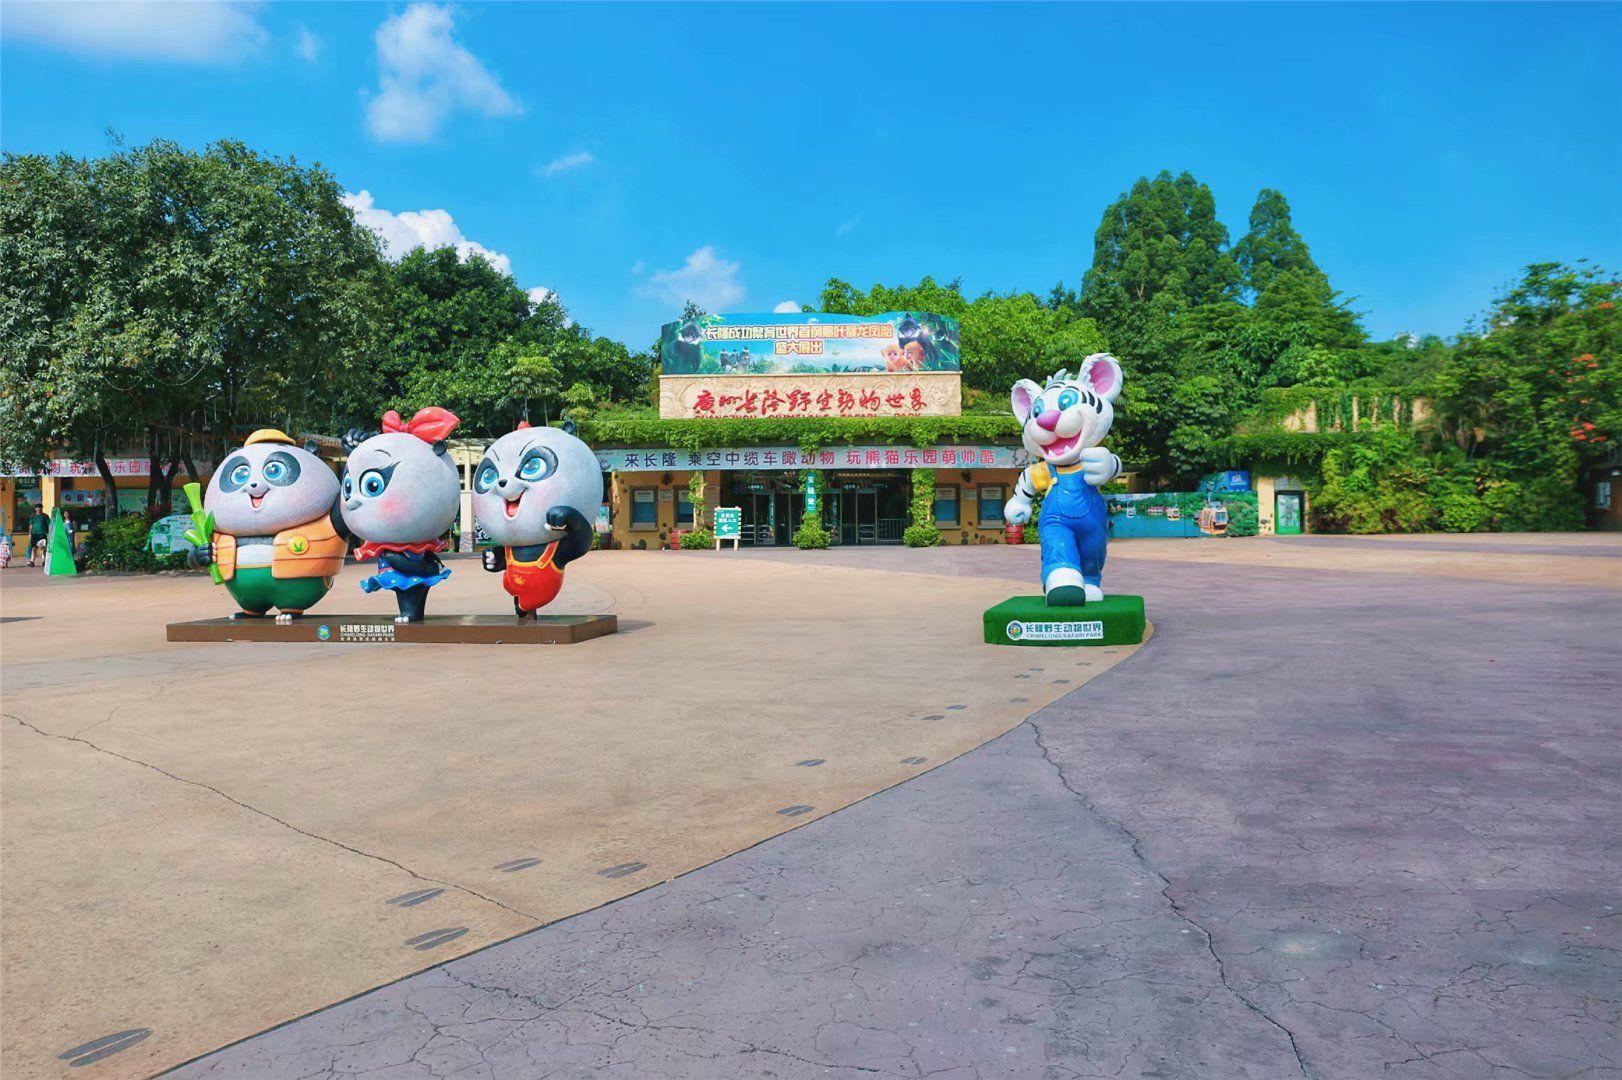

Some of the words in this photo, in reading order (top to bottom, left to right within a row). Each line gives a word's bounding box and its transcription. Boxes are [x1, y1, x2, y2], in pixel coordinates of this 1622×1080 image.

[624, 452, 676, 468] 来长隆
[846, 449, 995, 465] 玩熊猫乐园萌帅酷
[1026, 623, 1101, 632] 长隆野生动物世界
